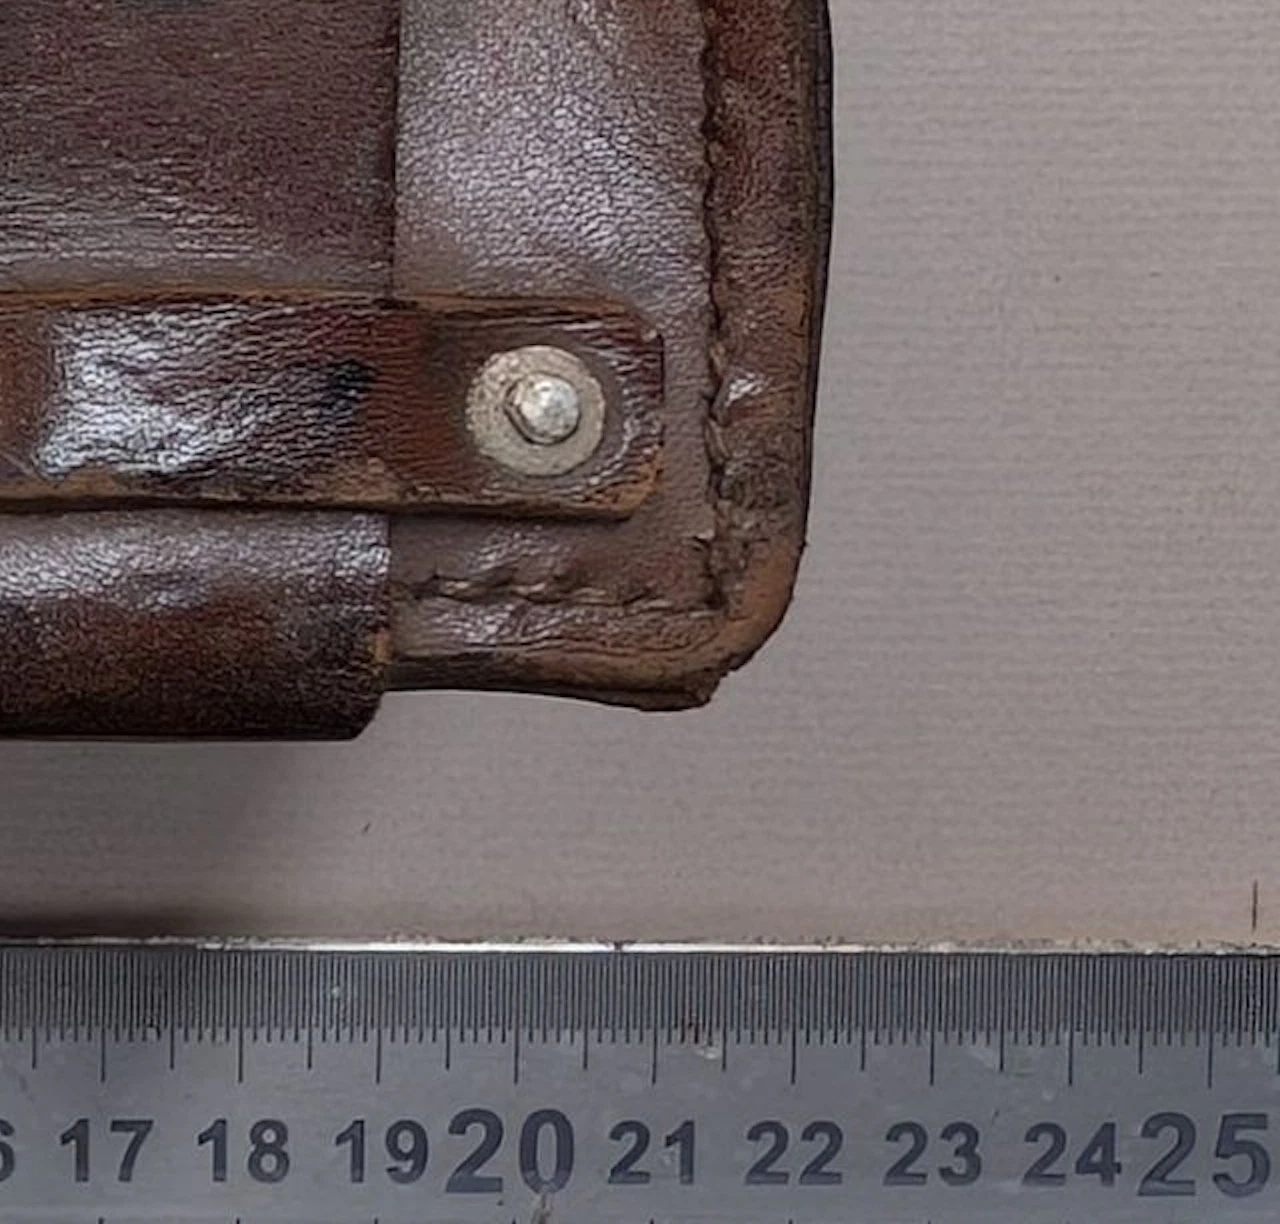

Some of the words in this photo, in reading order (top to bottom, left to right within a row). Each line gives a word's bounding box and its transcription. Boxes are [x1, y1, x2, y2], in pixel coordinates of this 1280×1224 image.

[60, 1118, 153, 1182] 17
[198, 1118, 290, 1183] 18
[336, 1120, 428, 1184] 19
[446, 1108, 574, 1193] 20
[608, 1120, 695, 1184] 21
[746, 1120, 843, 1185] 22
[885, 1122, 982, 1185] 23
[1024, 1122, 1122, 1185] 24
[1137, 1112, 1271, 1197] 25
